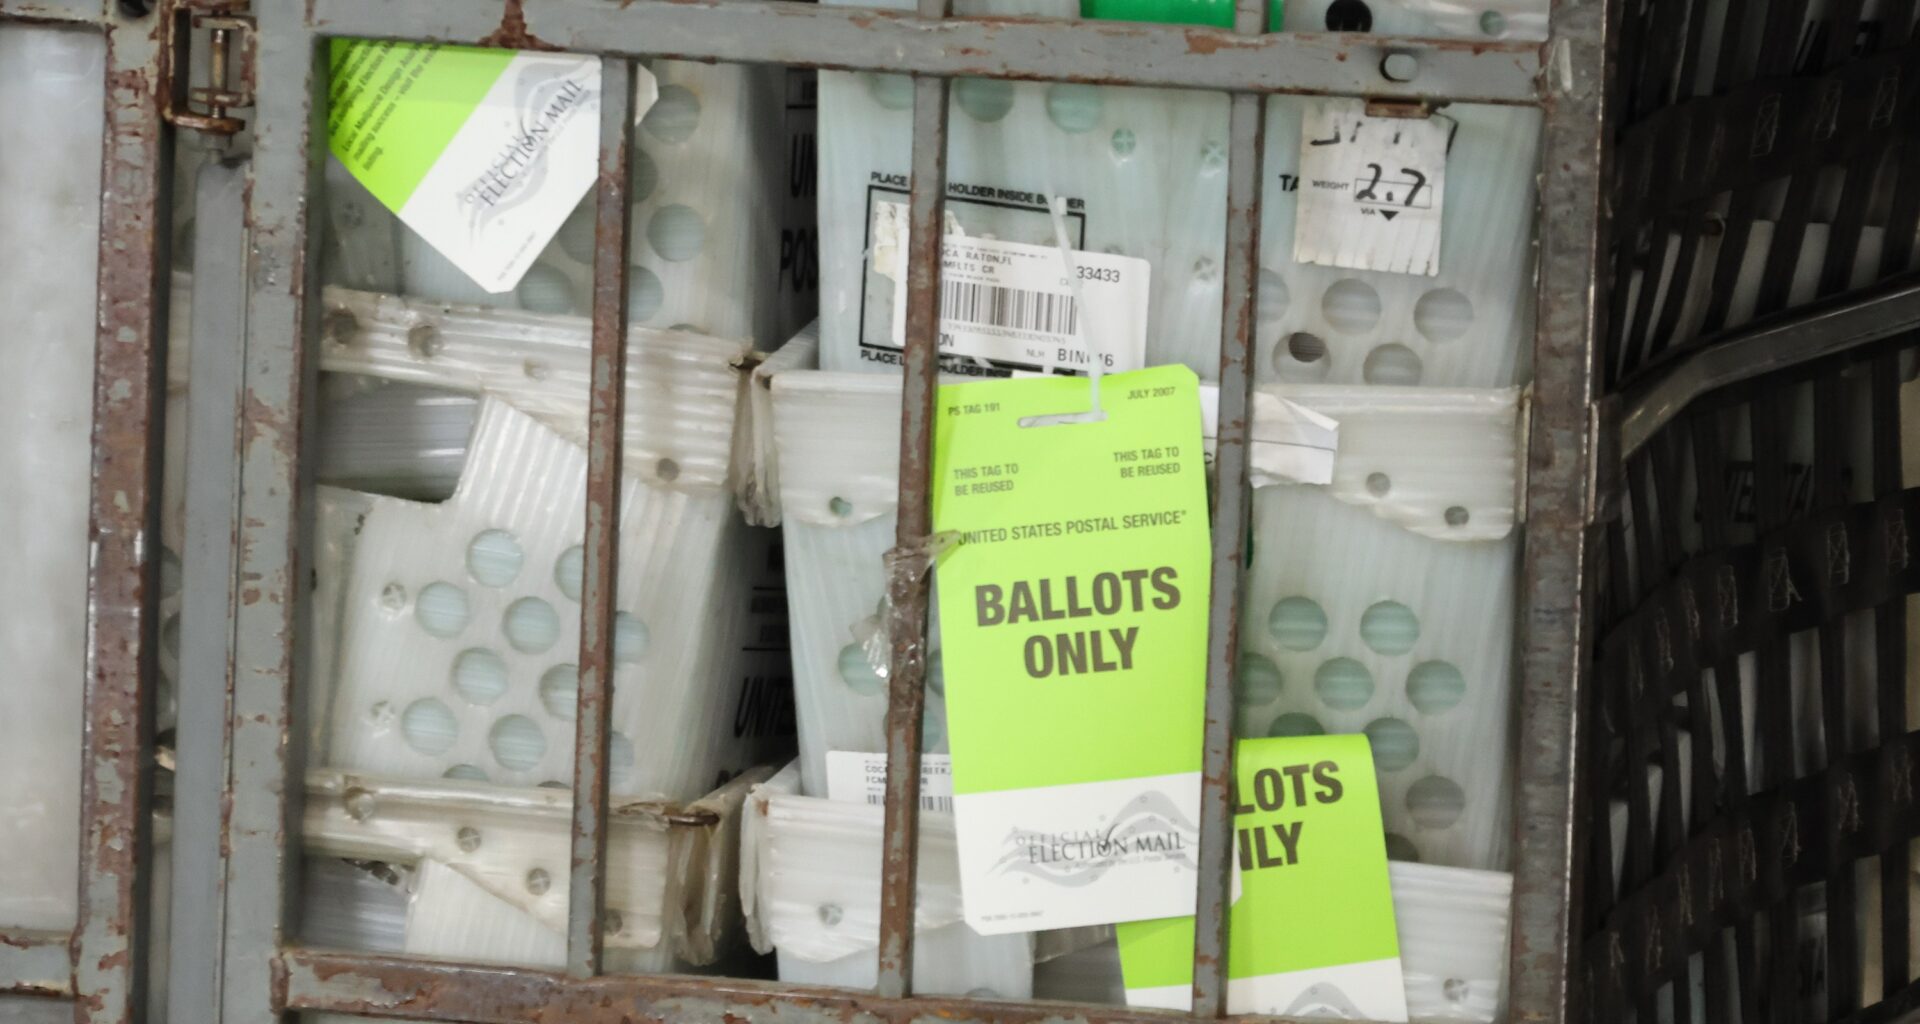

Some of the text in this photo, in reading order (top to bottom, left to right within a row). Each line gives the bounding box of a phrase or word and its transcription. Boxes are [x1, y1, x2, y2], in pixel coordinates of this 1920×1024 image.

[479, 125, 549, 206] ELECTION
[545, 80, 583, 123] MAIL
[871, 172, 907, 187] PLACE
[949, 182, 995, 198] HOLDER
[997, 188, 1034, 203] INSIDE
[1312, 180, 1350, 191] WEIGHT
[1355, 163, 1426, 207] 2.7
[1361, 208, 1376, 216] VIA
[1076, 266, 1121, 283] 33433
[861, 349, 897, 365] PLACE
[1127, 386, 1175, 400] JULY 2007
[948, 402, 1000, 416] PS TAG 191
[1113, 446, 1179, 463] THIS TAG TO
[954, 463, 1019, 480] THIS TAG TO
[1120, 462, 1180, 478] BE REUSED
[955, 480, 1014, 496] BE REUSED
[958, 528, 1007, 546] UNITED
[1012, 522, 1062, 540] STATES
[1066, 516, 1118, 534] POSTAL
[975, 566, 1181, 627] BALLOTS
[1024, 626, 1140, 679] ONLY
[1016, 828, 1100, 846] OFFICIAL
[1029, 836, 1128, 864] ELECTION
[1136, 831, 1186, 852] MAIL
